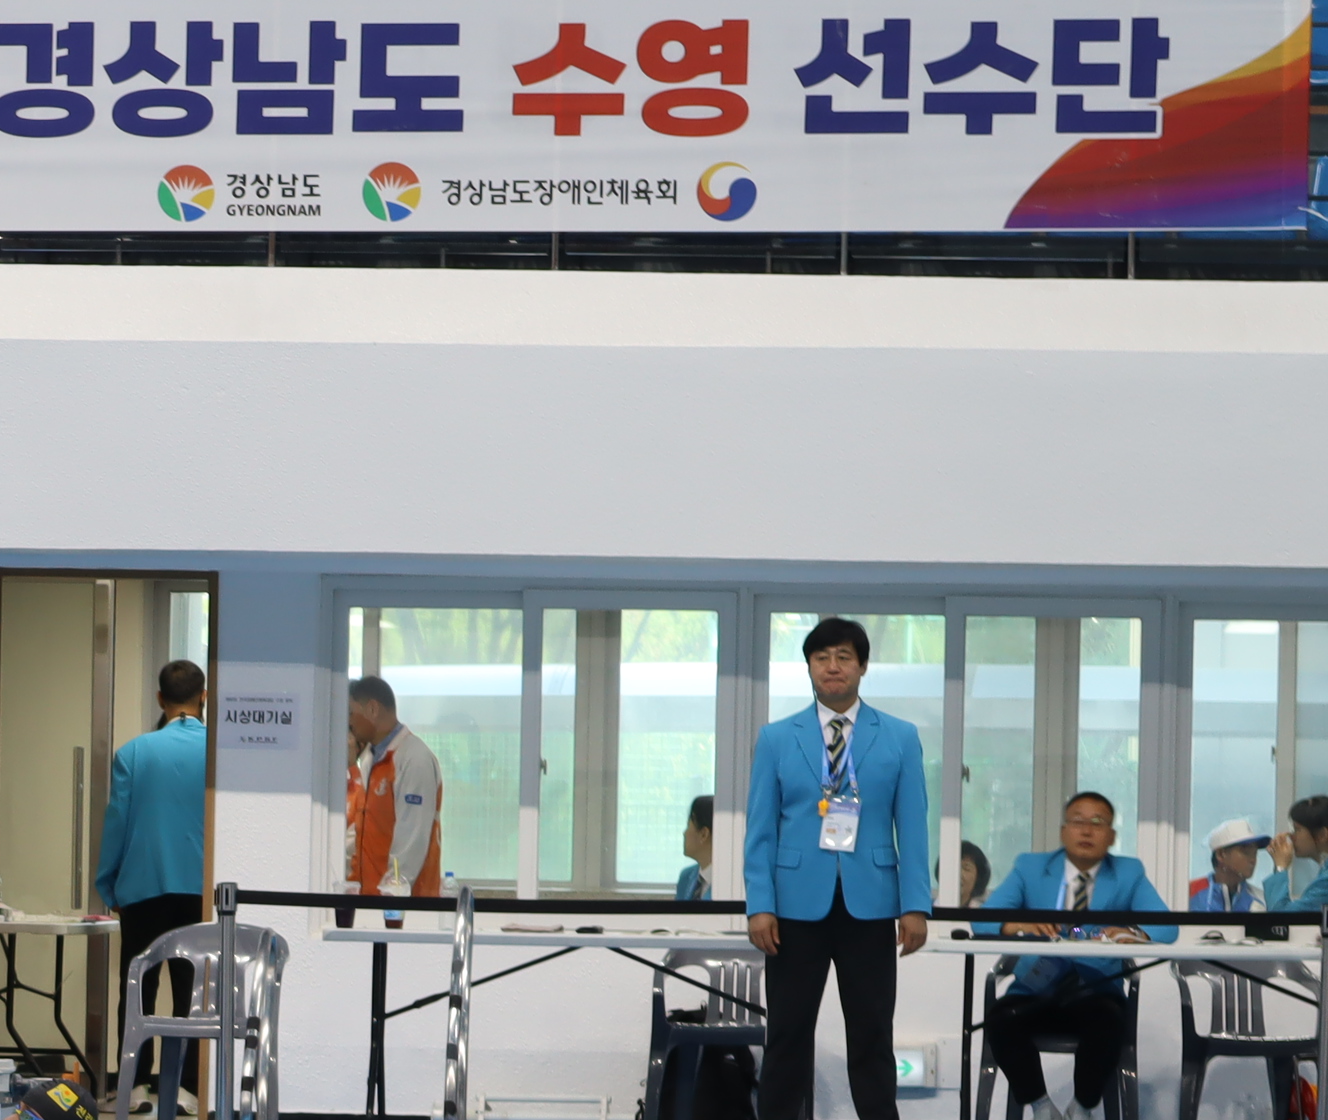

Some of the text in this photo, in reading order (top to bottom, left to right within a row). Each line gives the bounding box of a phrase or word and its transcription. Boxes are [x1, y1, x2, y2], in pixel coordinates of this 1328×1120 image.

[511, 18, 750, 138] 수영
[794, 16, 1170, 137] 선수단
[226, 173, 321, 199] 경상남도
[440, 176, 678, 206] 경상남도장애인체육회
[226, 204, 321, 217] GYEONGNAM
[225, 709, 292, 725] 시상대기실
